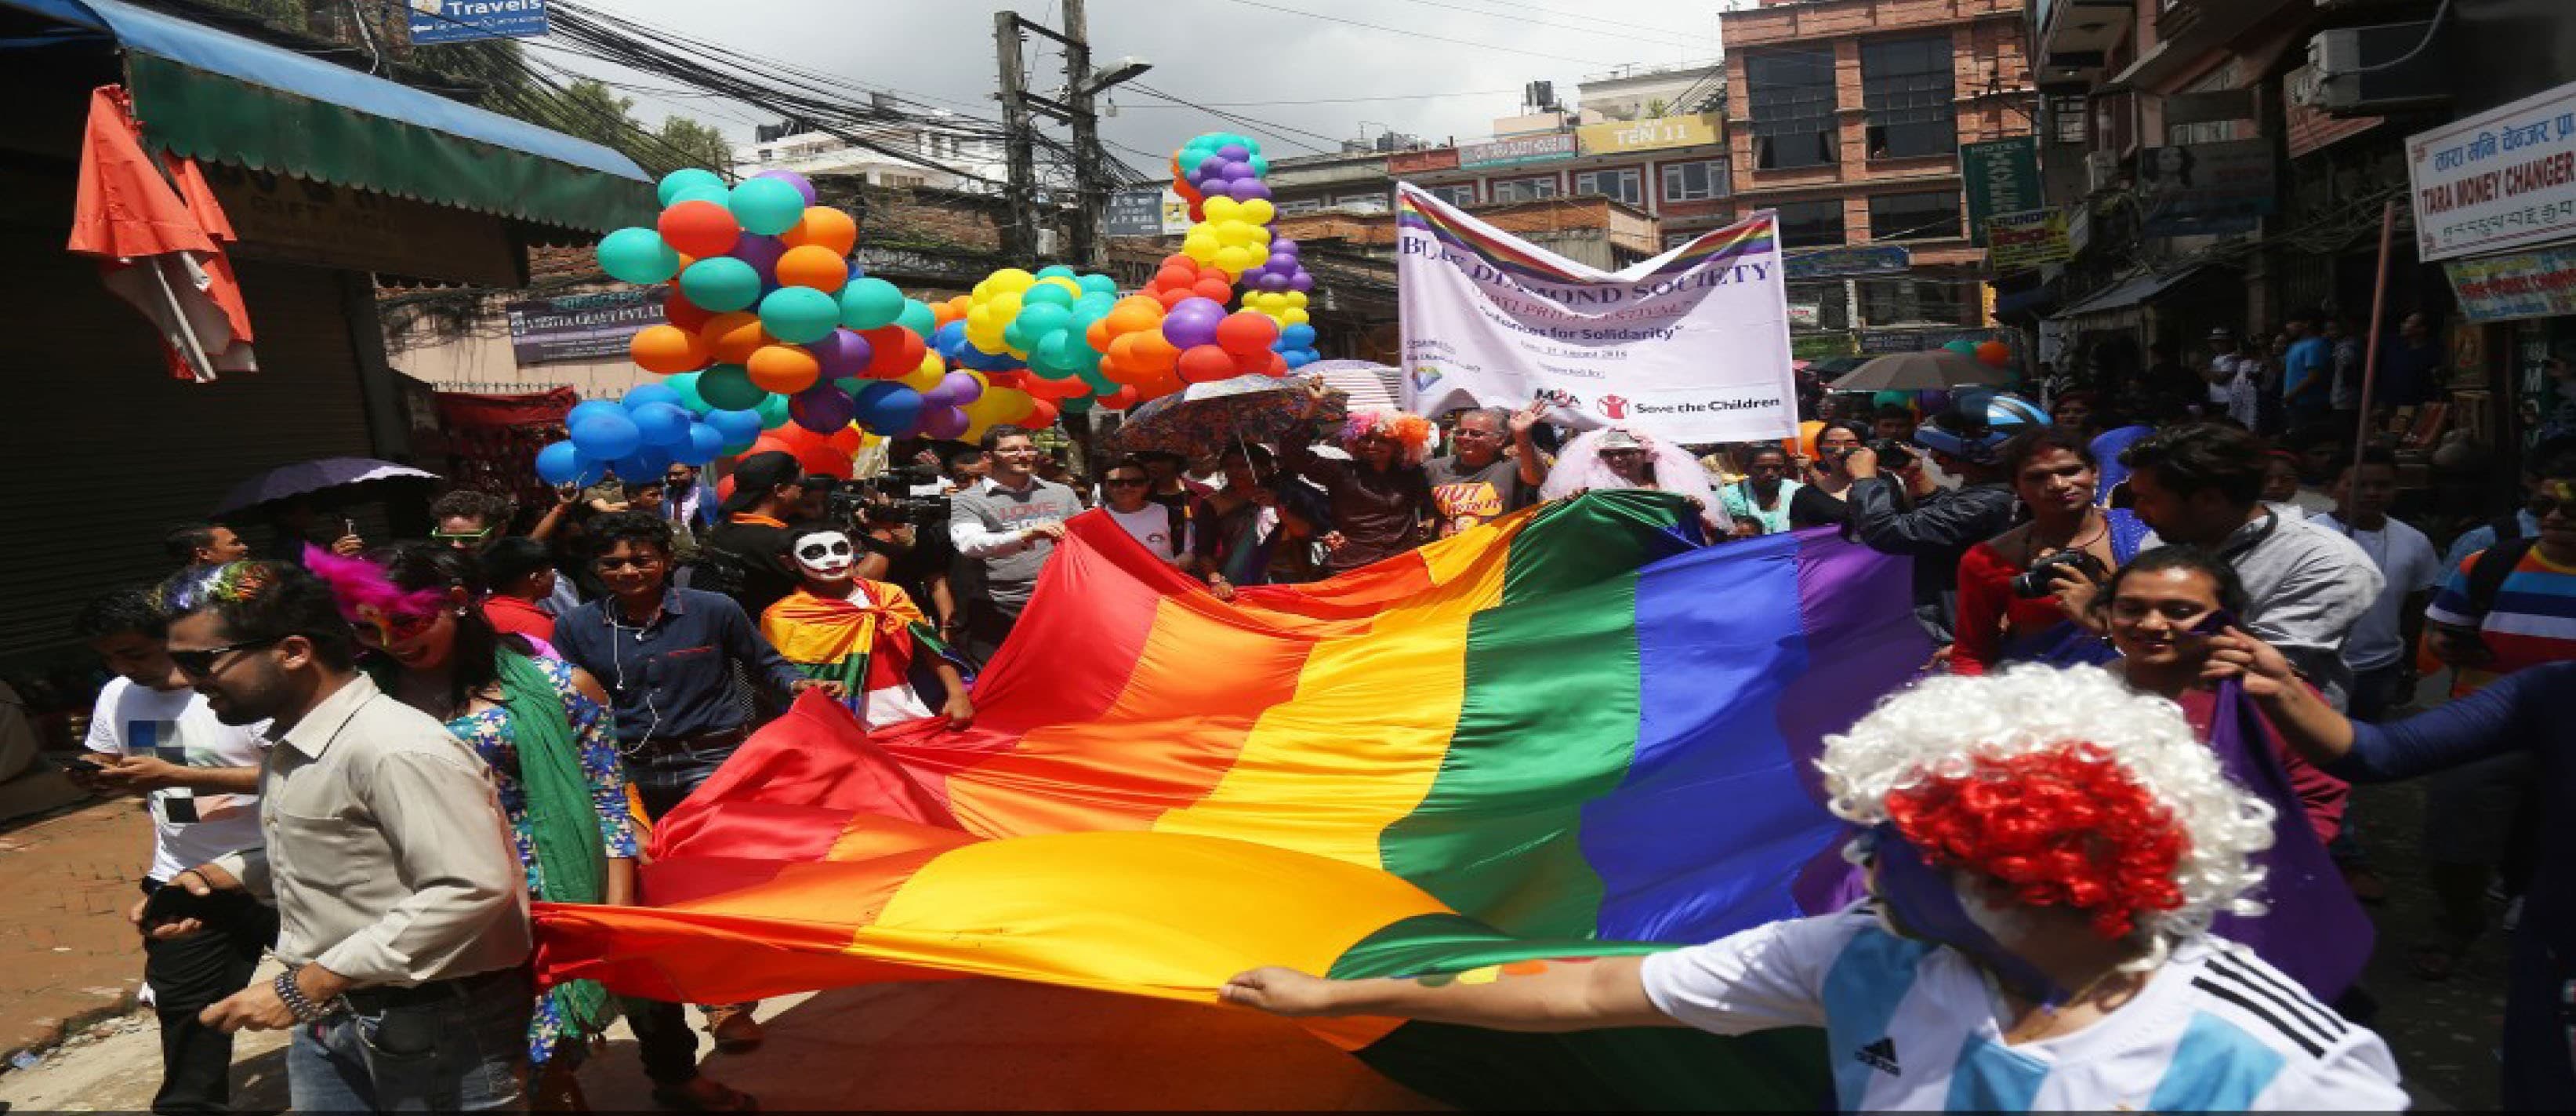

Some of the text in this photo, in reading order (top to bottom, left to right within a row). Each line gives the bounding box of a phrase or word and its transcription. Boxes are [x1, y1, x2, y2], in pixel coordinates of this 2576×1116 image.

[447, 0, 542, 16] Travels
[1613, 125, 1656, 145] TEN
[1971, 142, 2026, 154] HOTEL
[2422, 151, 2575, 215] TARA MONEY CHANGER
[1551, 328, 1578, 339] for
[1634, 397, 1780, 414] Save the Children
